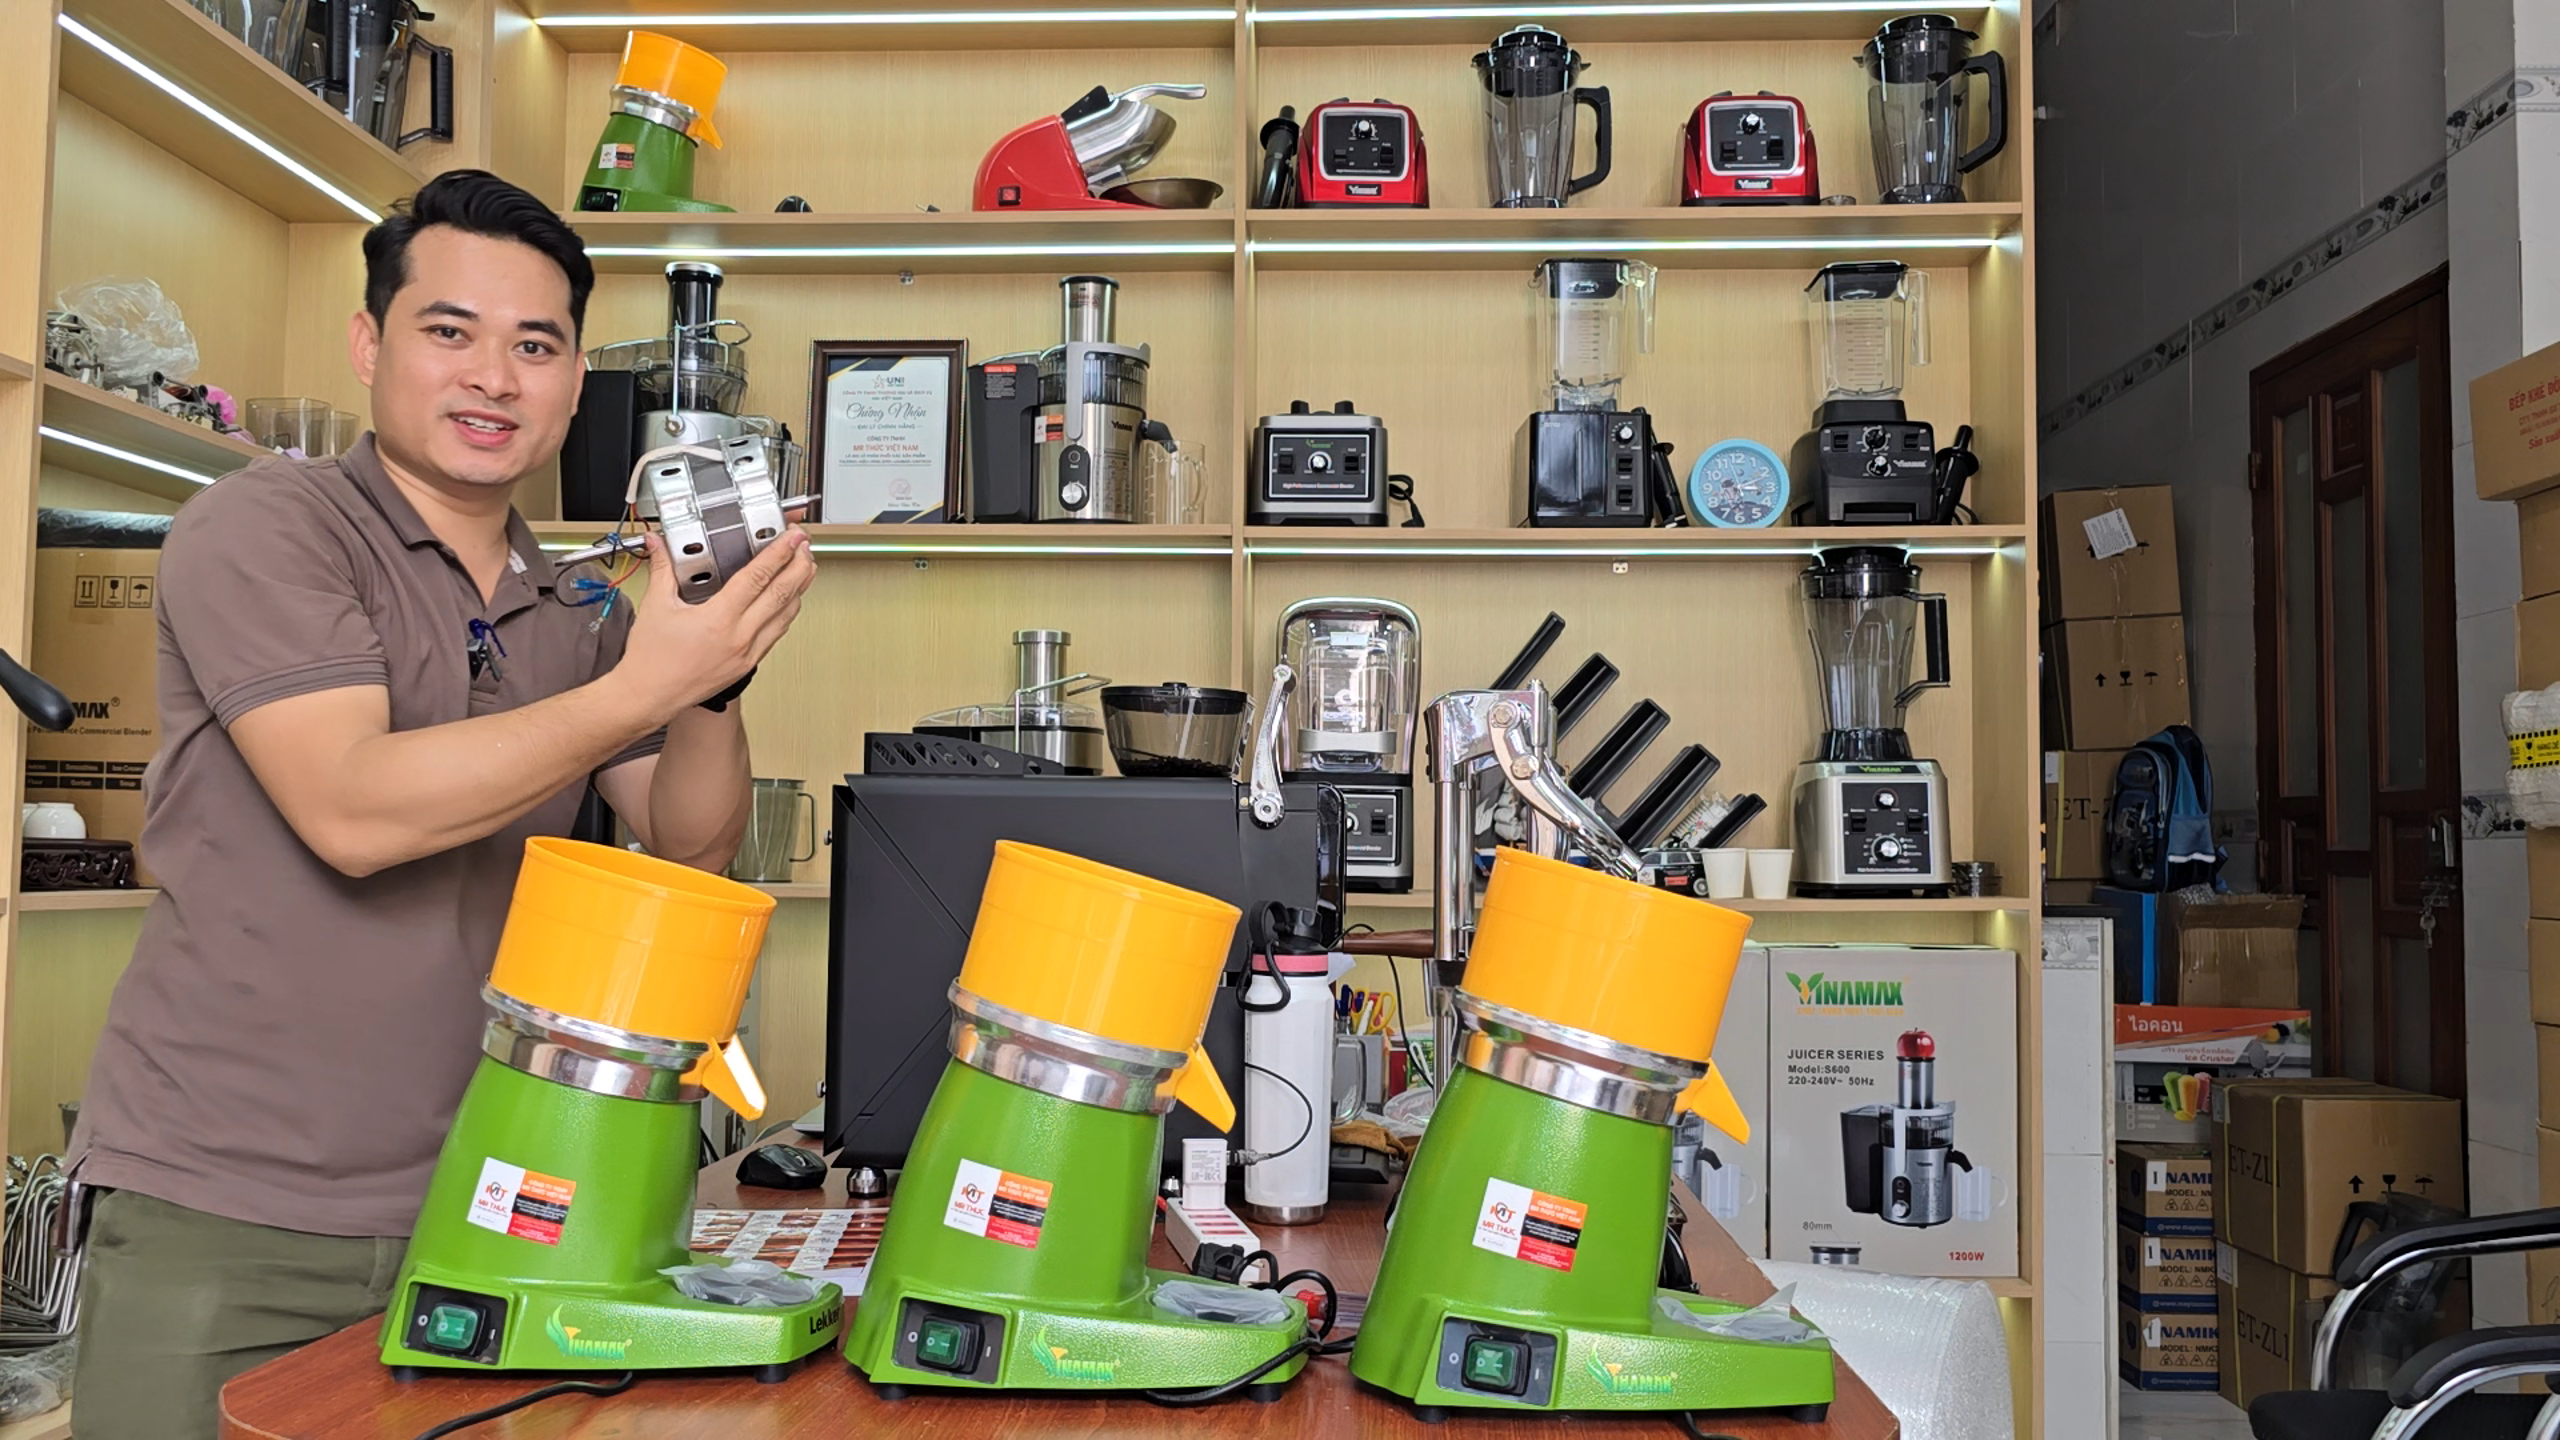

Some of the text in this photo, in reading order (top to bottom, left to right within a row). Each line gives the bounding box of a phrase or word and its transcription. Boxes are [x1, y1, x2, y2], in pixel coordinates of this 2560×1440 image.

[846, 402, 926, 422] Chứng Nhận
[1715, 458, 1728, 469] 11
[1730, 453, 1745, 464] 12
[1750, 457, 1756, 467] 1
[1706, 470, 1721, 480] 10
[1760, 467, 1770, 477] 2
[1703, 483, 1713, 494] 9
[1765, 482, 1776, 492] 3
[1707, 496, 1719, 508] 8
[1760, 496, 1772, 507] 4
[1720, 508, 1730, 519] 7
[1734, 511, 1745, 523] 6
[1751, 508, 1762, 519] 5
[1785, 971, 1904, 1006] VINAMAX
[2128, 1014, 2183, 1033] ไอคอน
[1787, 1049, 1884, 1060] JUICER SERIES
[2200, 1054, 2236, 1062] Crusher
[1788, 1065, 1850, 1074] Model:S600
[1848, 1077, 1874, 1086] 50Hz
[2228, 1144, 2281, 1188] ET-ZL1
[2165, 1188, 2199, 1197] MODEL:
[1802, 1221, 1833, 1231] 80mm
[1949, 1252, 1984, 1261] 1200W
[2160, 1265, 2192, 1273] MODEL:
[2238, 1308, 2289, 1362] ET-ZL1
[2160, 1344, 2193, 1352] MODEL:
